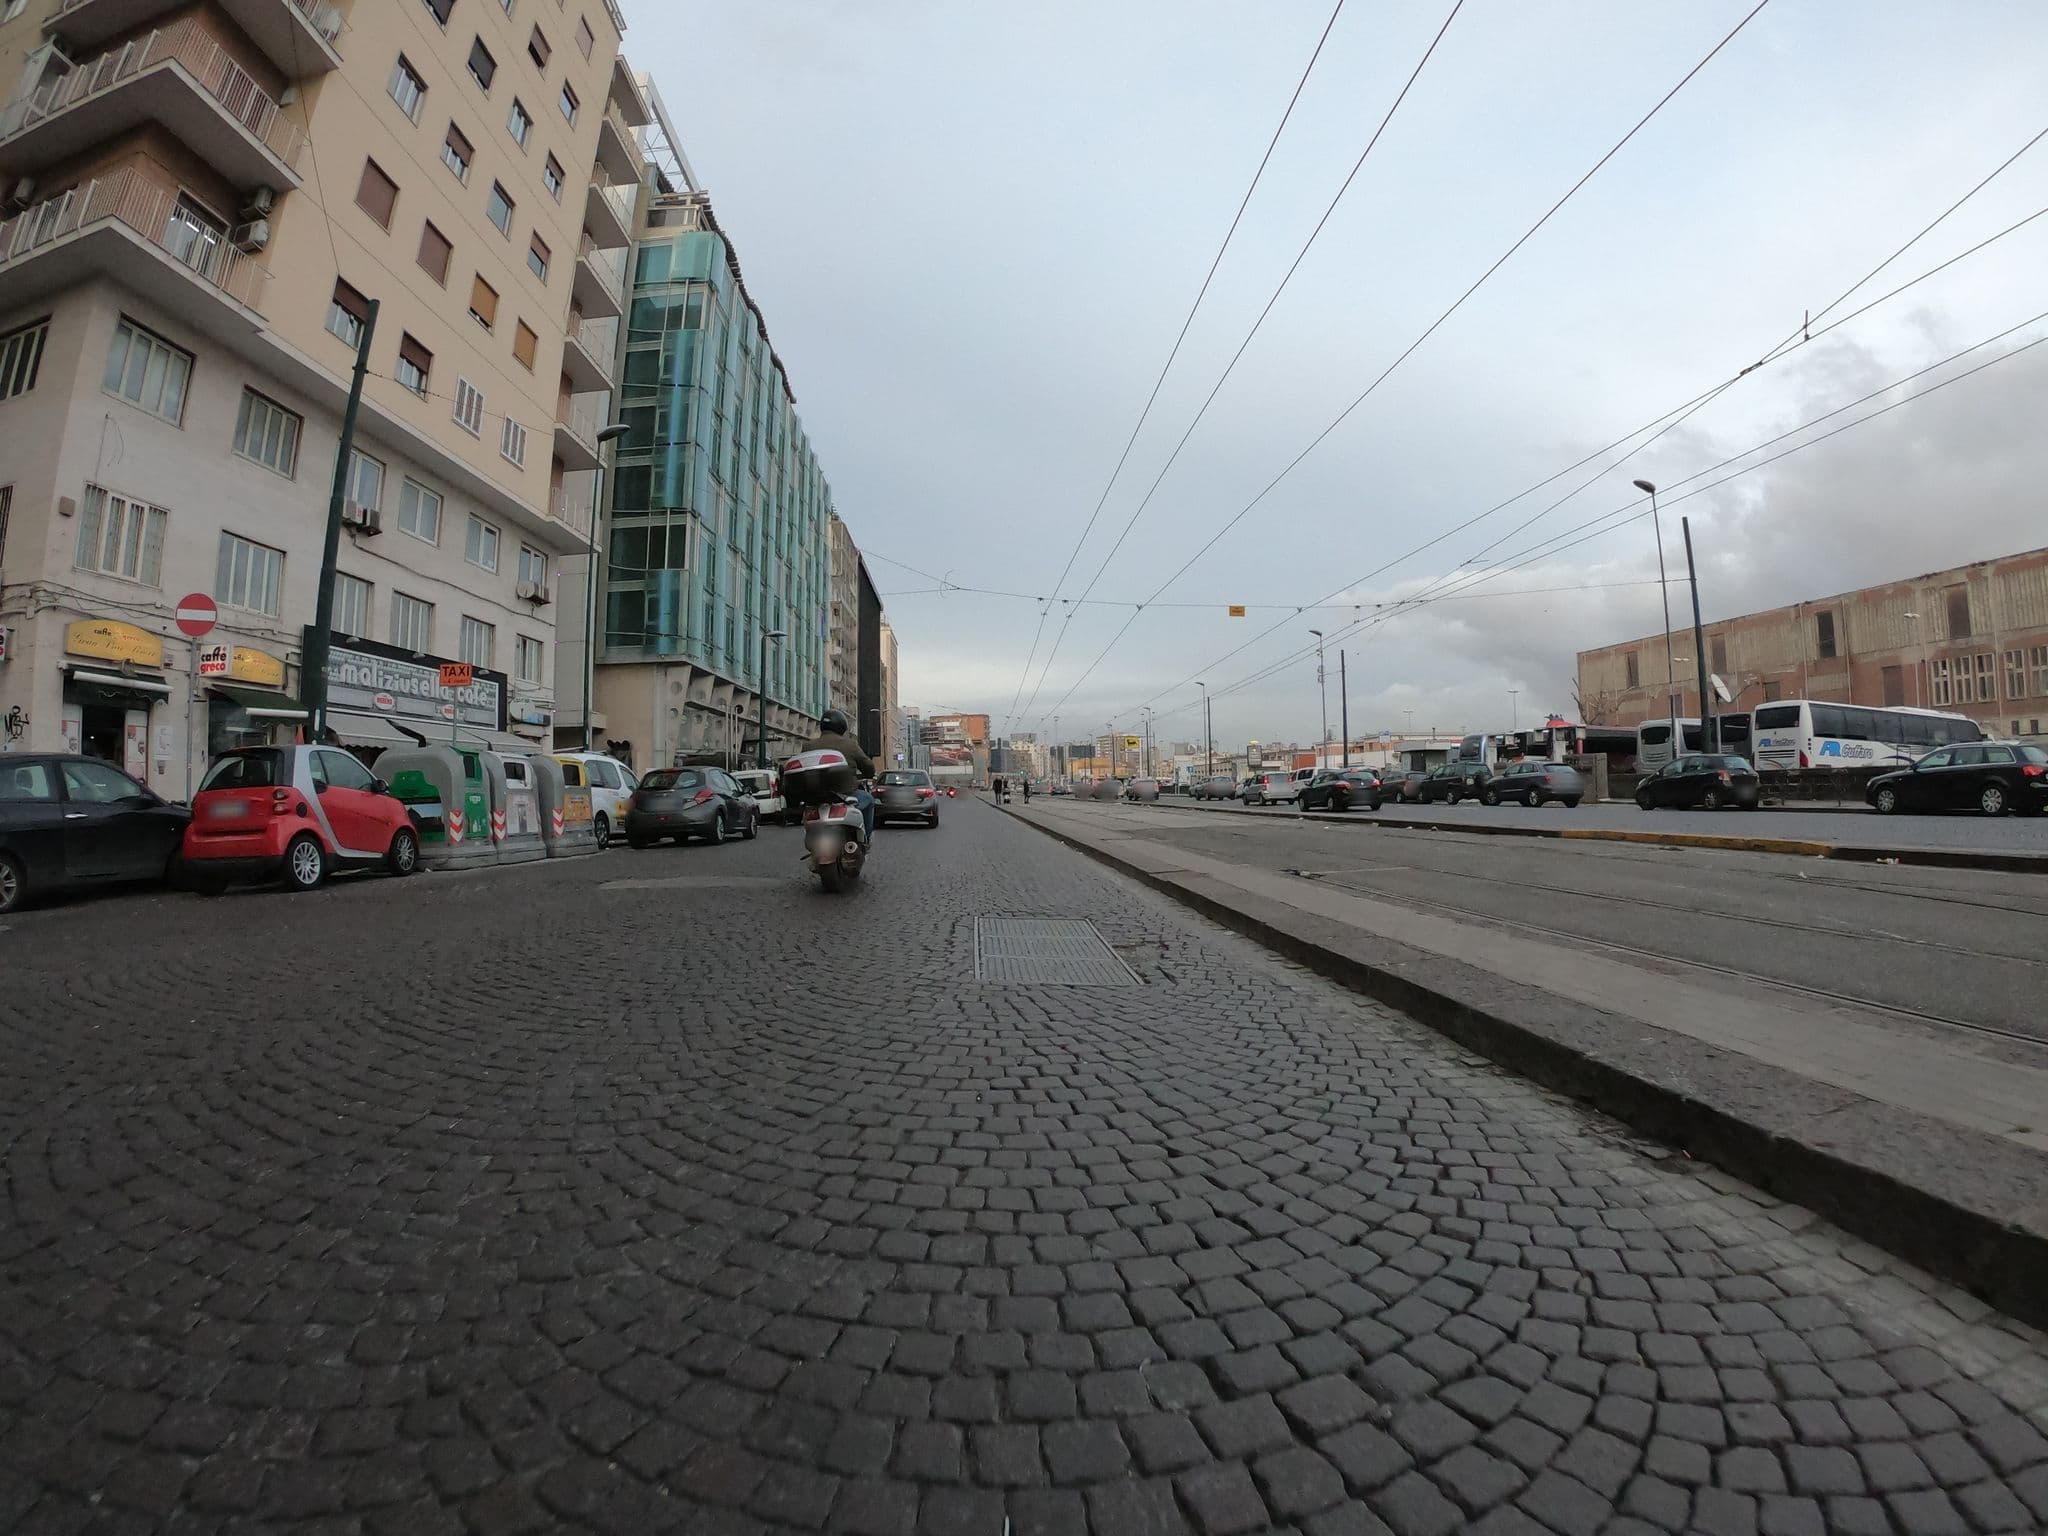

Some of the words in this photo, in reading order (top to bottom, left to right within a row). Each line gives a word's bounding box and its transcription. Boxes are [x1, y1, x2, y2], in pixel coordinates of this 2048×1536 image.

[199, 662, 226, 675] greco
[441, 666, 471, 677] TAXI
[1841, 742, 1874, 760] Cuffaro
